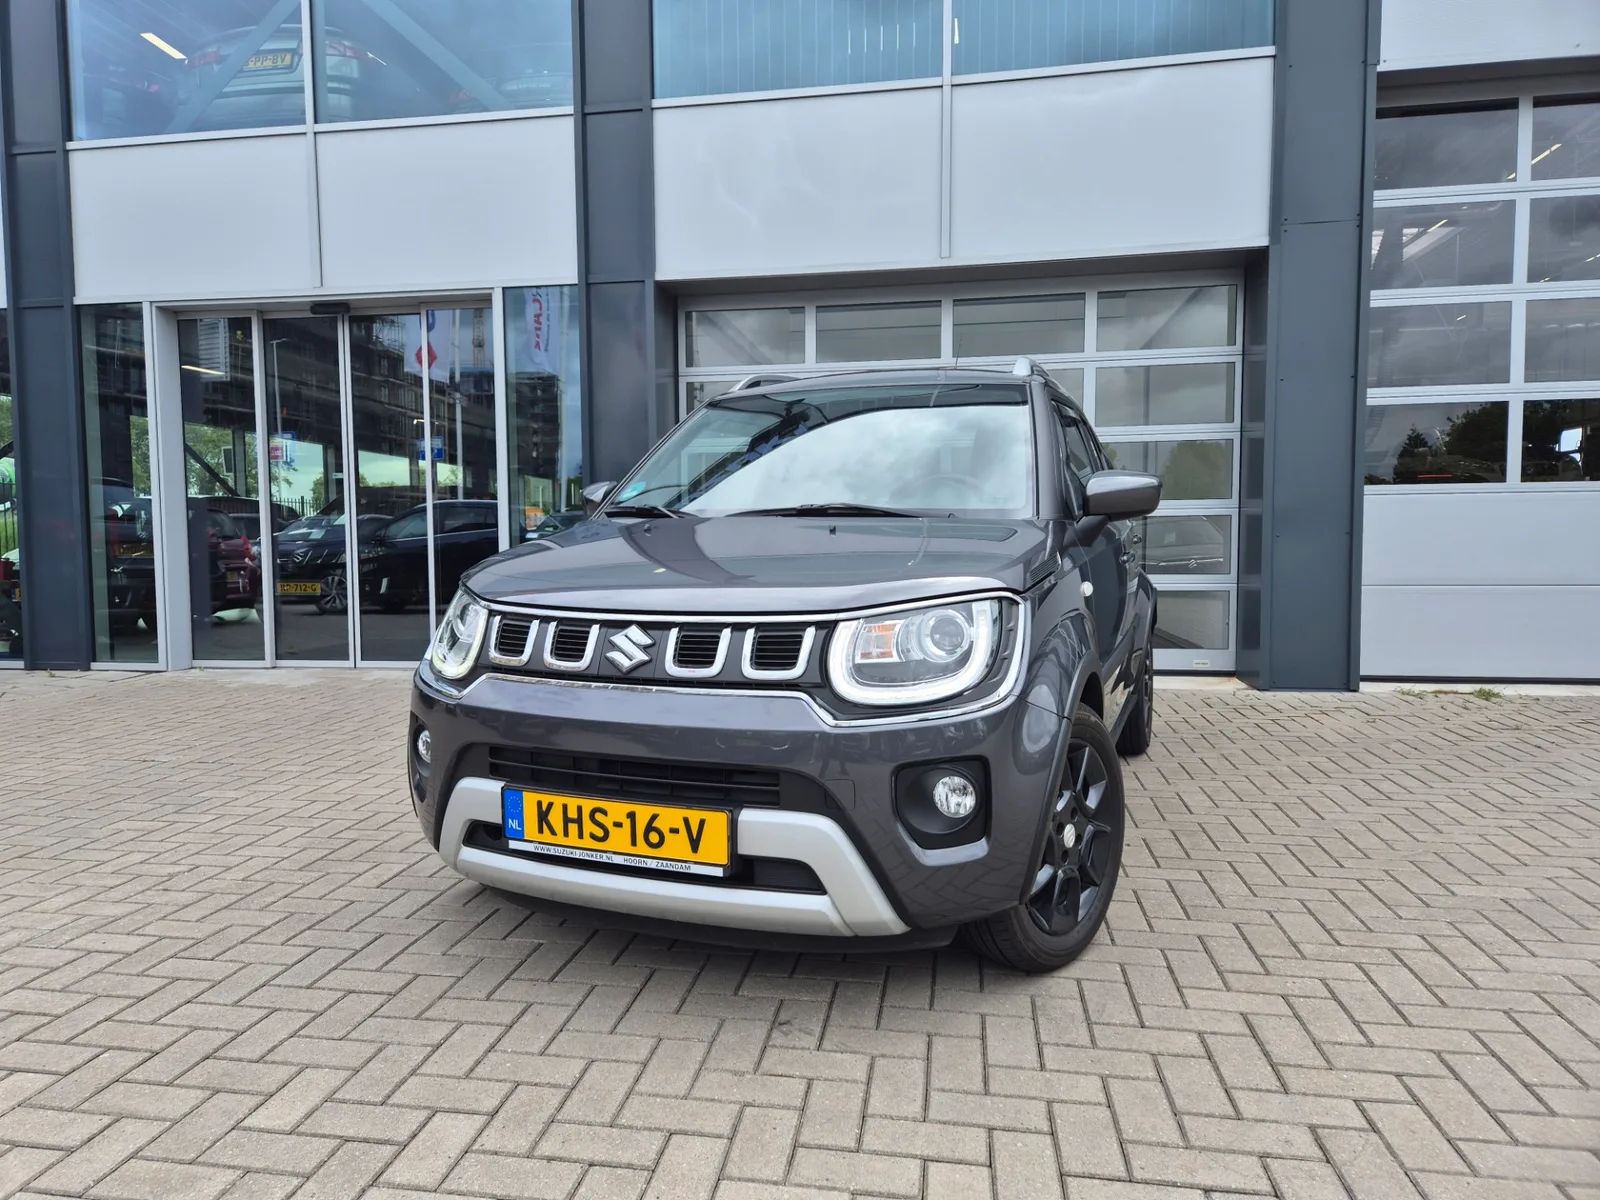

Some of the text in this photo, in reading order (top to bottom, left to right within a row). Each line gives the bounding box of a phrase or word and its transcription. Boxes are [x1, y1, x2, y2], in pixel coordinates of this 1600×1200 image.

[508, 818, 522, 831] NL
[536, 799, 707, 855] KHS-16-V
[623, 857, 648, 866] HOORN
[655, 861, 692, 872] ZAANDAM
